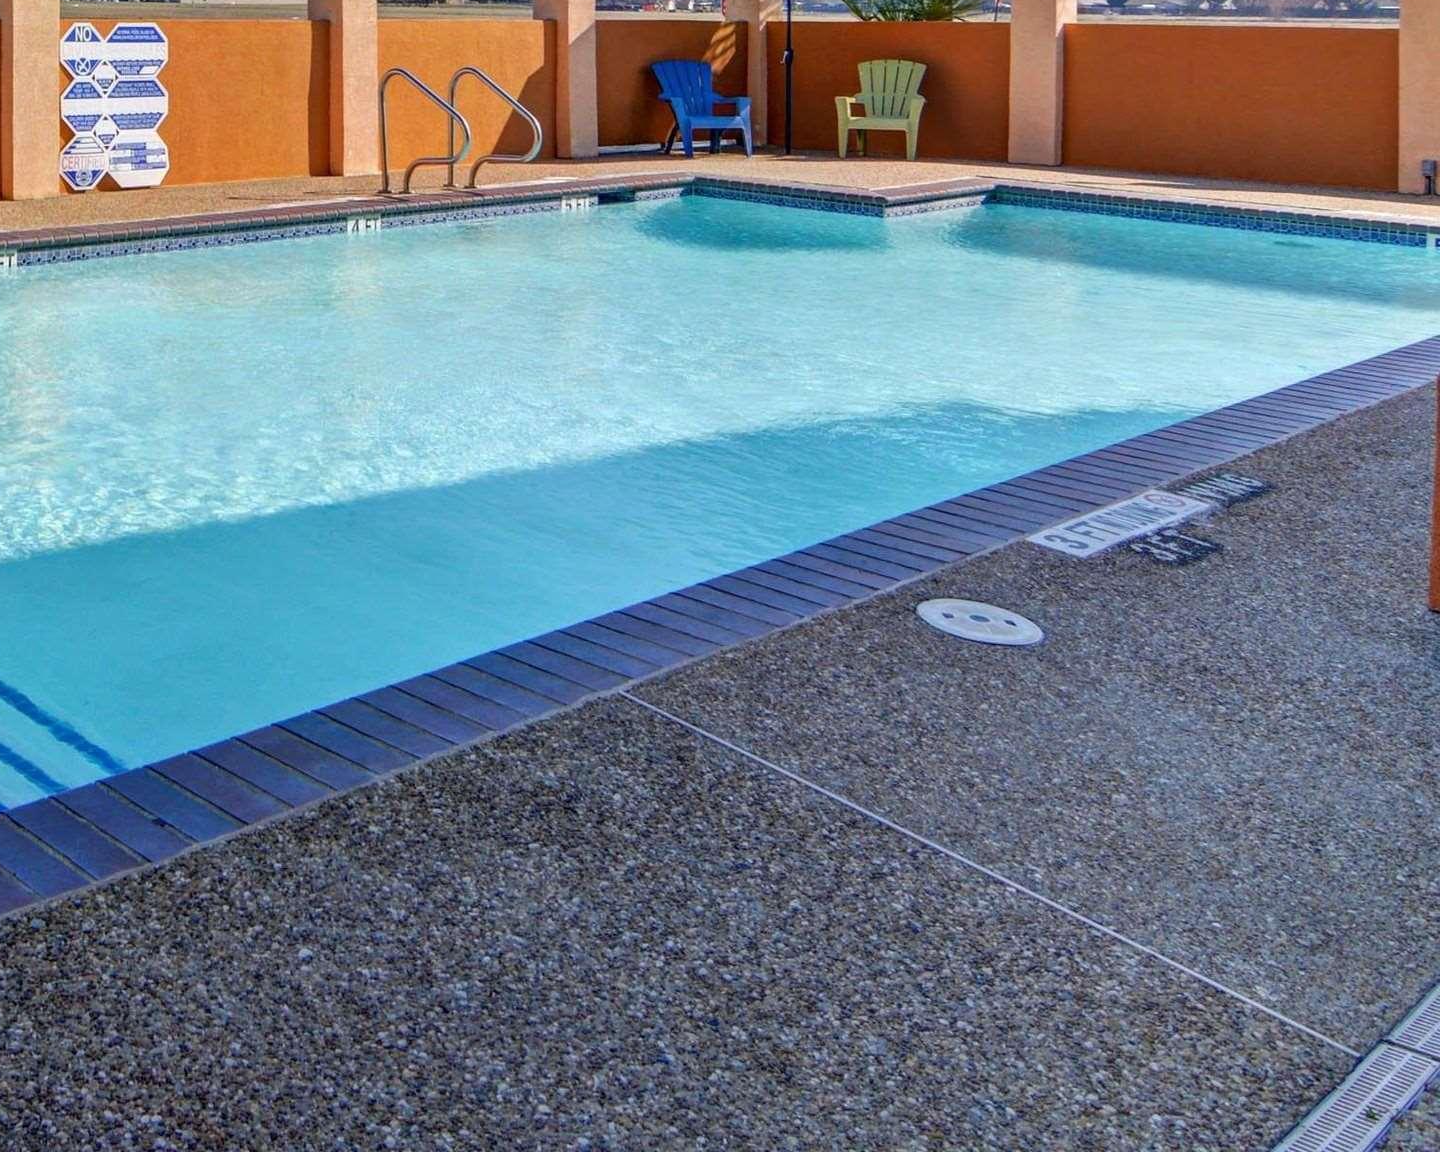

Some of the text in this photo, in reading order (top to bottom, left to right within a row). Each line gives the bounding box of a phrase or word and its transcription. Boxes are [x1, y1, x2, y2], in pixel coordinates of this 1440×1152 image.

[75, 26, 92, 42] NO
[351, 218, 379, 232] 4 FT
[1062, 521, 1121, 541] FT
[1043, 534, 1089, 550] 3
